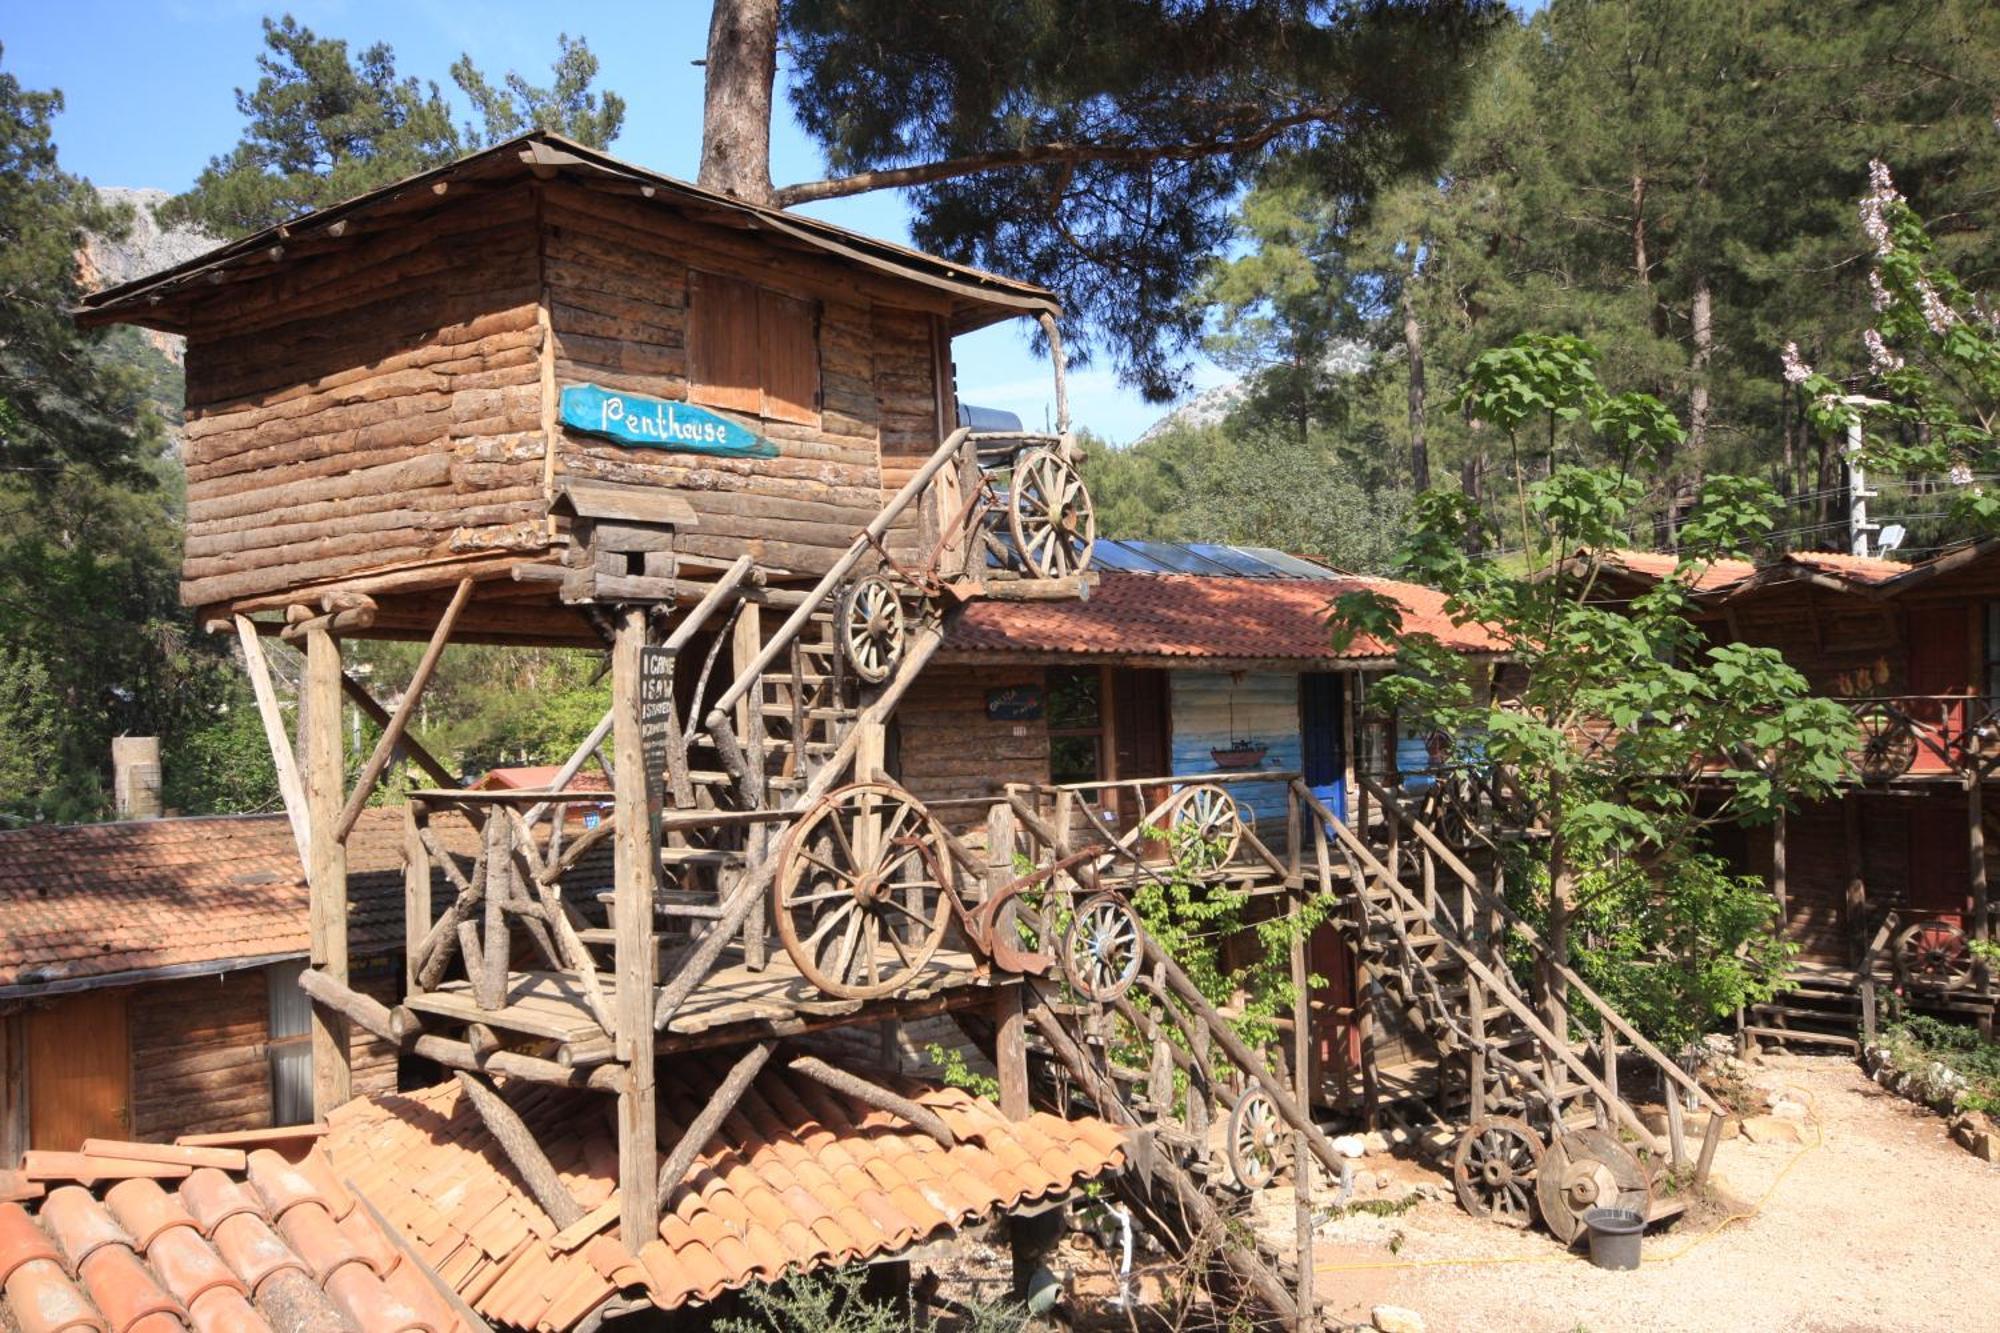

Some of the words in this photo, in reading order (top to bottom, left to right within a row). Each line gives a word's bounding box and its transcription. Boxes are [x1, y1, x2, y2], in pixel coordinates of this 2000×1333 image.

[601, 397, 727, 445] Penthouse
[643, 654, 649, 675] I
[650, 654, 676, 675] CAME
[642, 680, 647, 699] I
[648, 678, 674, 700] SAW
